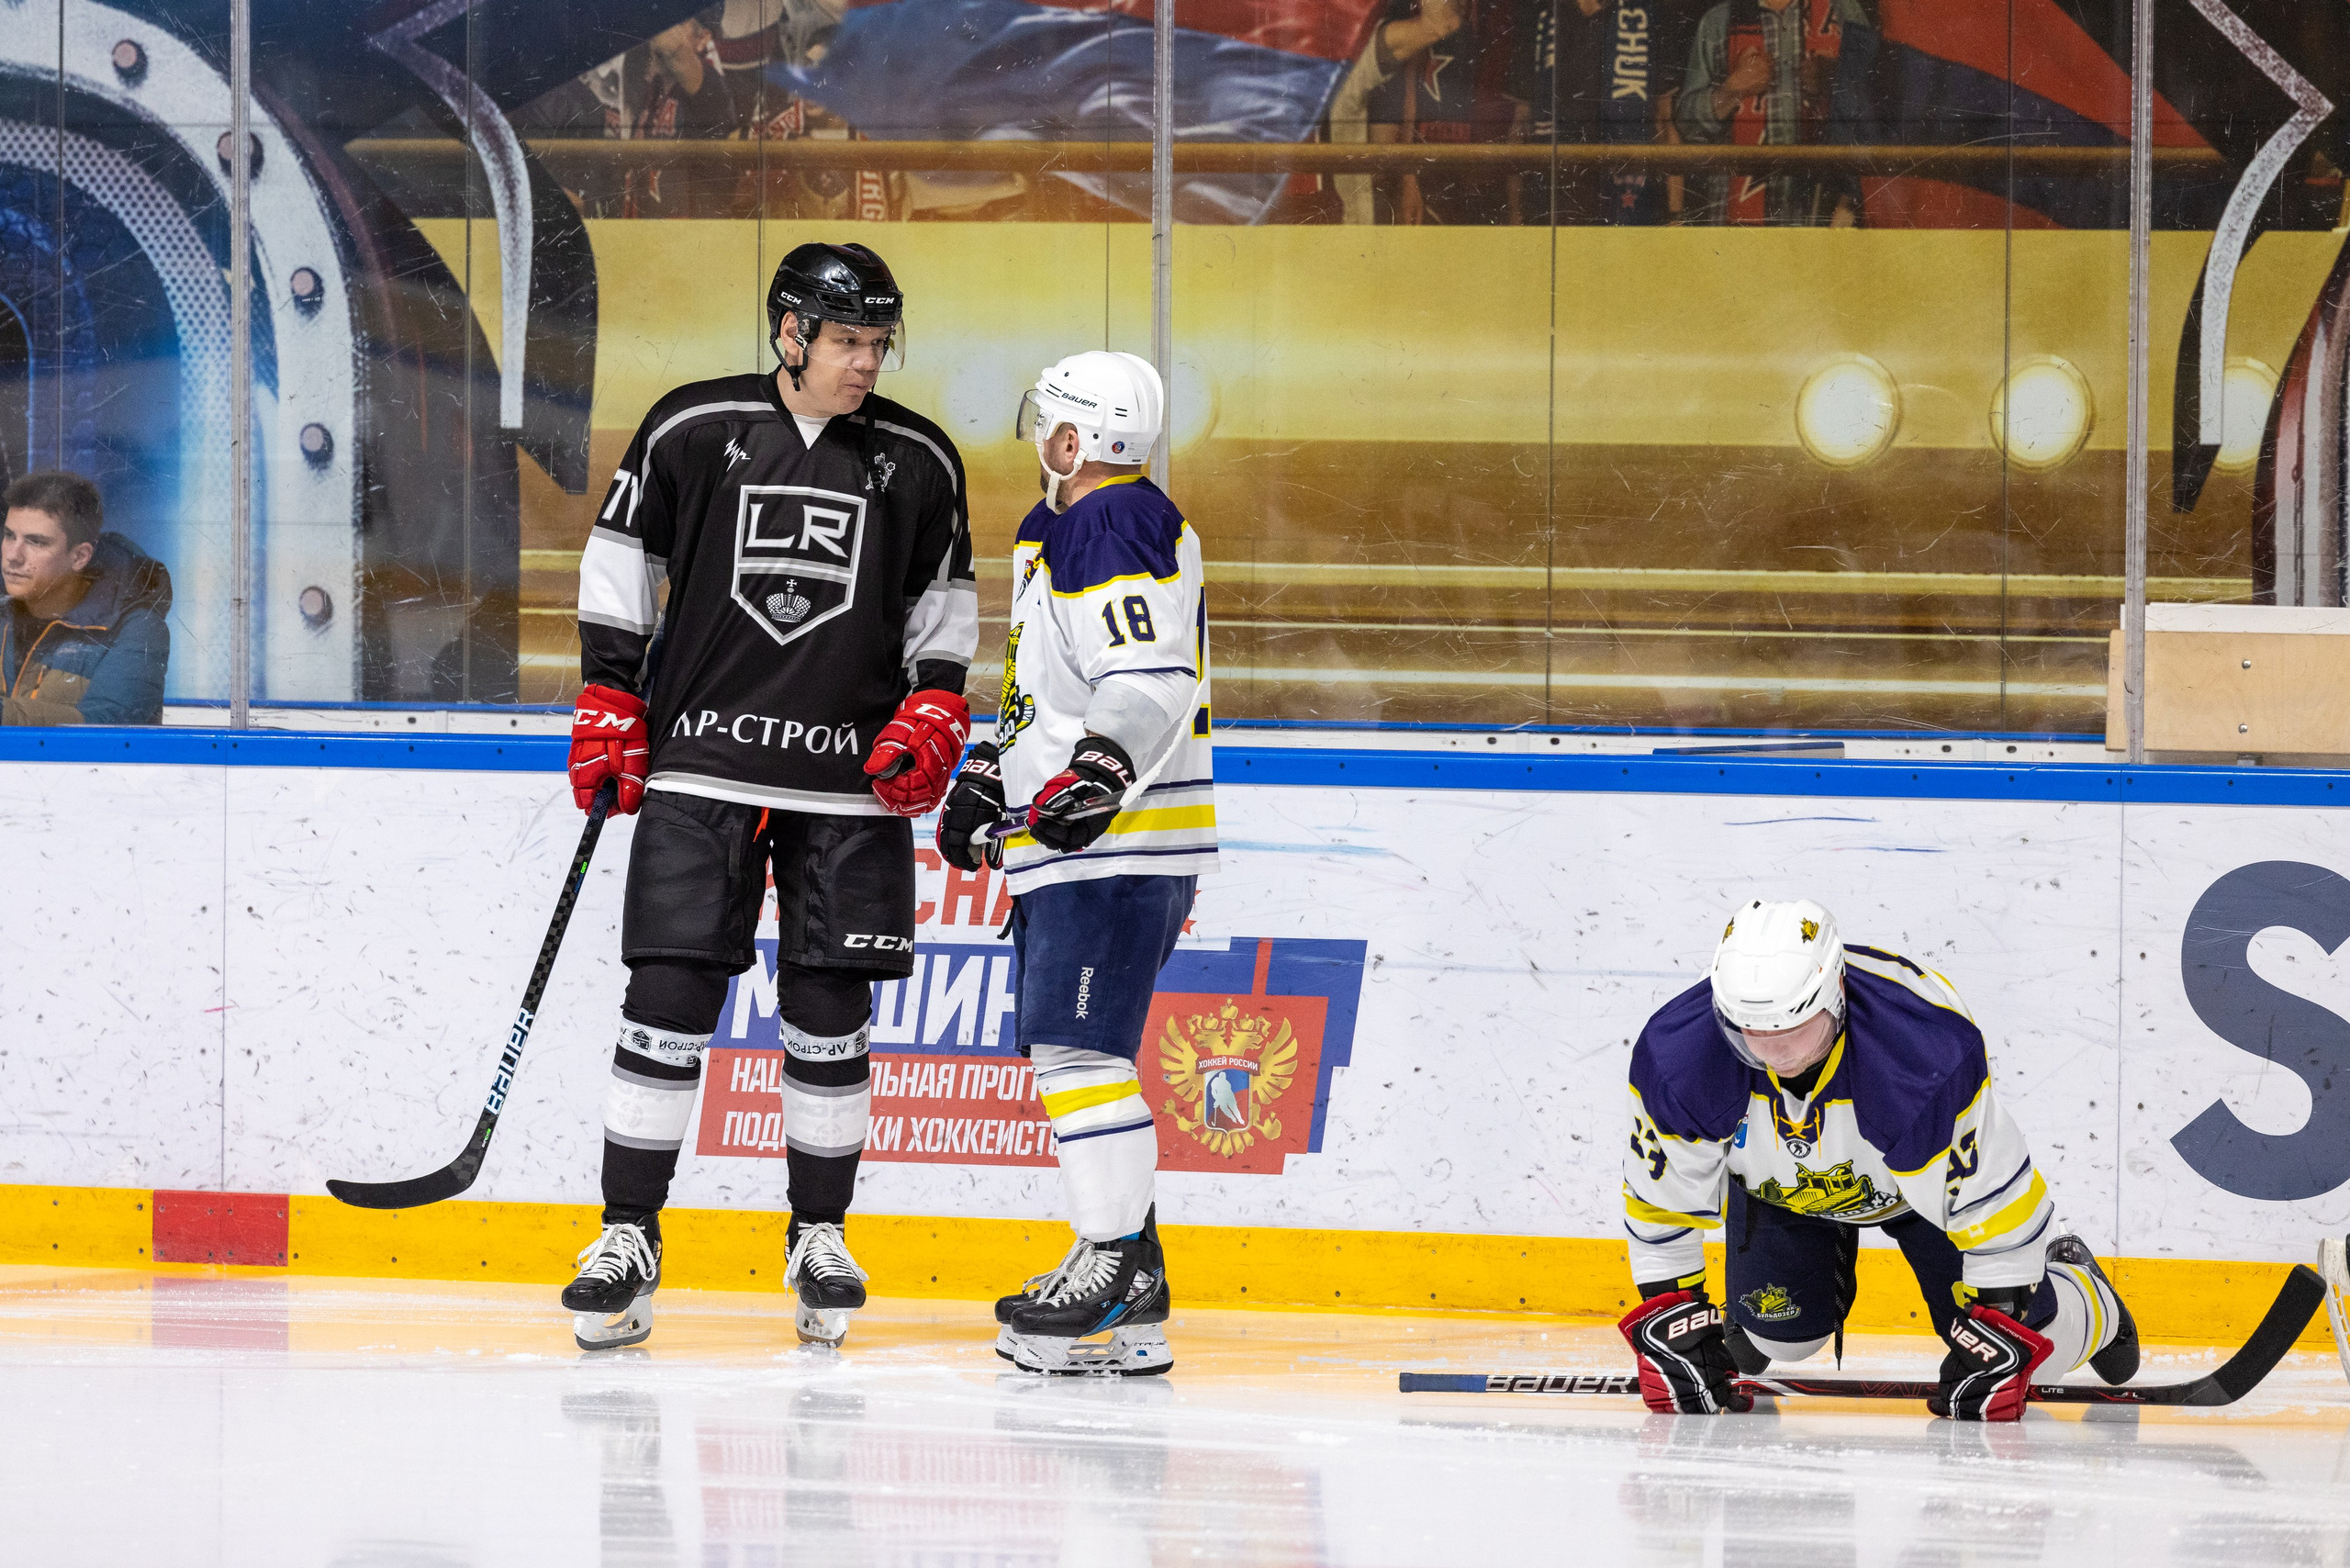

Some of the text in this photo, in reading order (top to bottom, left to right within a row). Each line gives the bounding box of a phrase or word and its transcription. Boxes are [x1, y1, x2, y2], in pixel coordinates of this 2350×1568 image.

[1612, 0, 1650, 102] ECHUK
[780, 291, 802, 305] CCM
[864, 297, 895, 305] CCM
[1061, 392, 1098, 409] BAUER
[744, 502, 852, 558] LR
[1102, 595, 1157, 649] 18
[574, 708, 637, 733] CM
[671, 709, 858, 756] ЛР-СТРОЙ
[914, 703, 968, 756] CC
[843, 933, 914, 953] CCM
[1075, 966, 1094, 1020] Reebok
[486, 1006, 534, 1116] BAUER
[1198, 1056, 1259, 1071] ХОККЕЙ РОССИИ
[1757, 1309, 1795, 1319] БУЛЬДОЗЕР
[1485, 1375, 1633, 1394] BAUER
